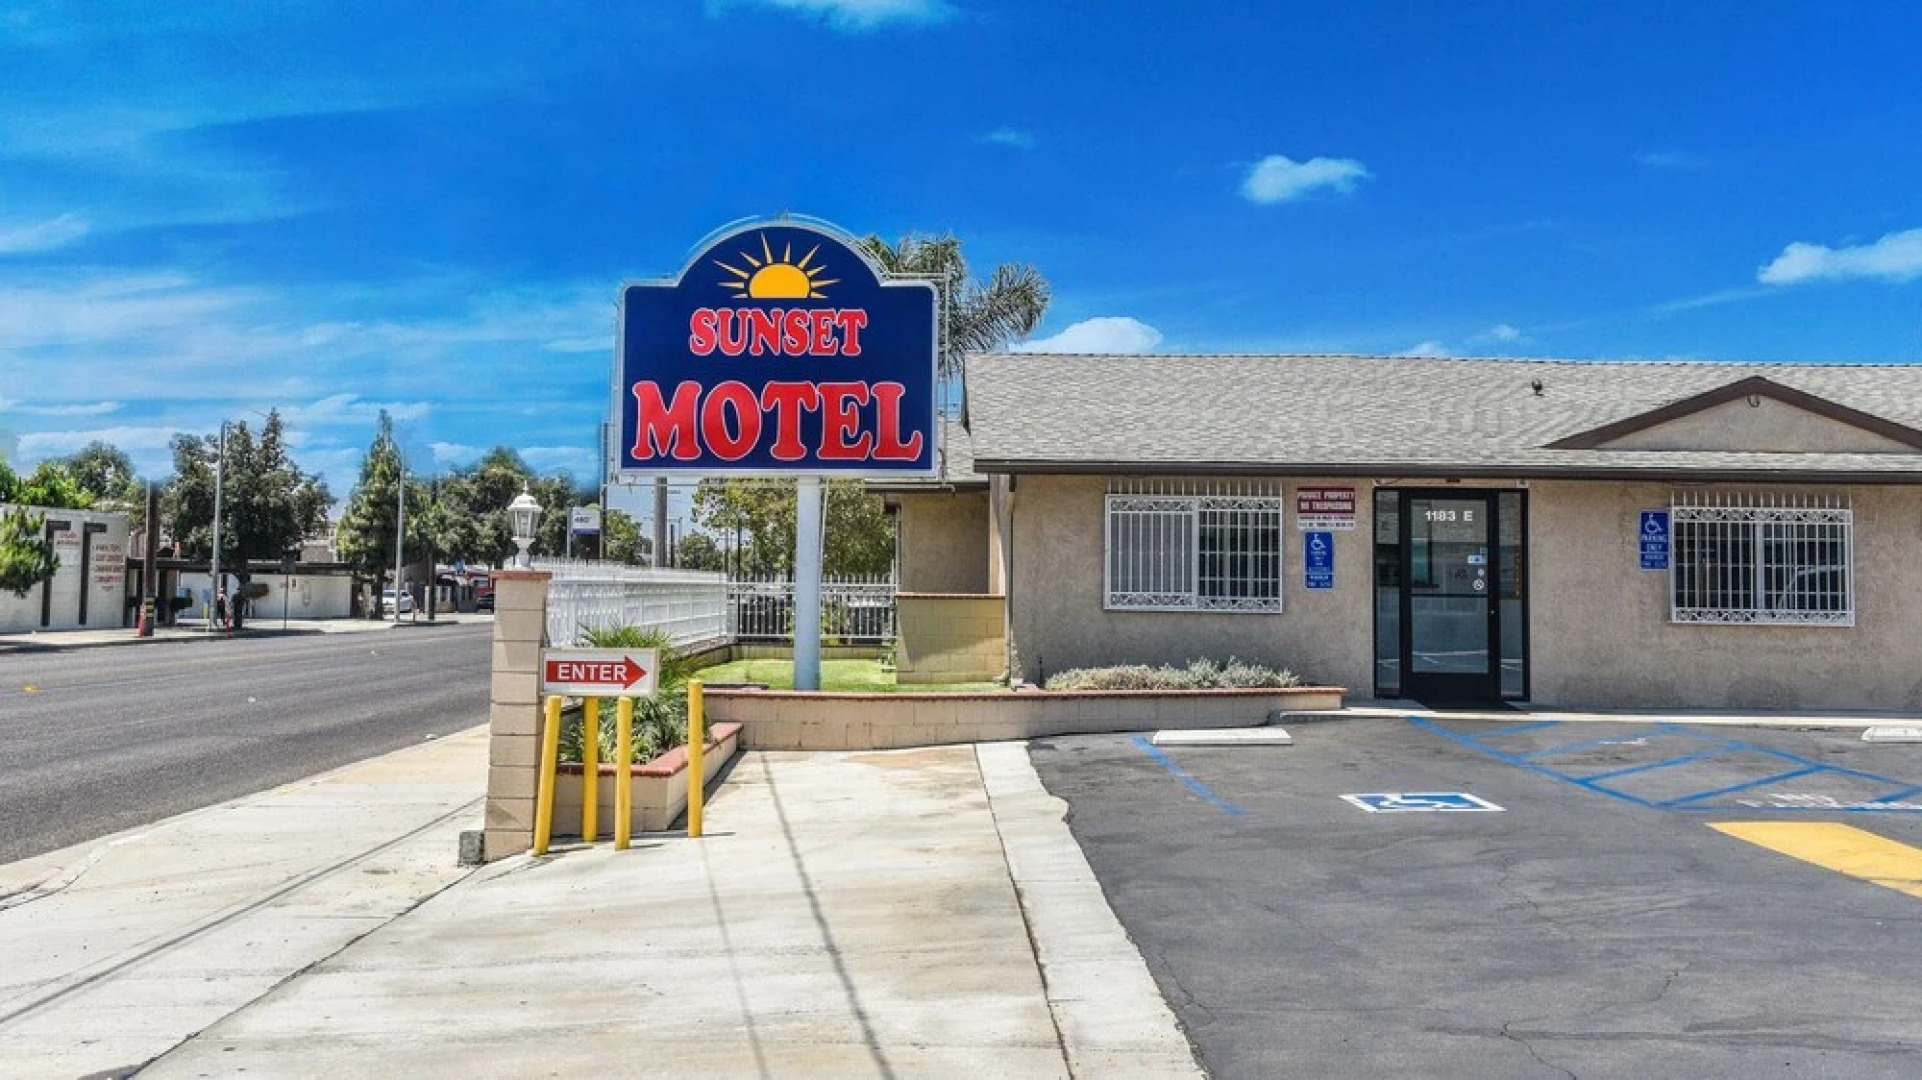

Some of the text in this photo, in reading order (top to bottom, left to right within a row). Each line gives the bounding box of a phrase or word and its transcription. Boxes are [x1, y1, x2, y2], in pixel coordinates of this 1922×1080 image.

[689, 308, 867, 356] SUNSET
[631, 380, 923, 461] MOTEL
[1425, 511, 1474, 522] 1183 E
[558, 662, 628, 681] ENTER
